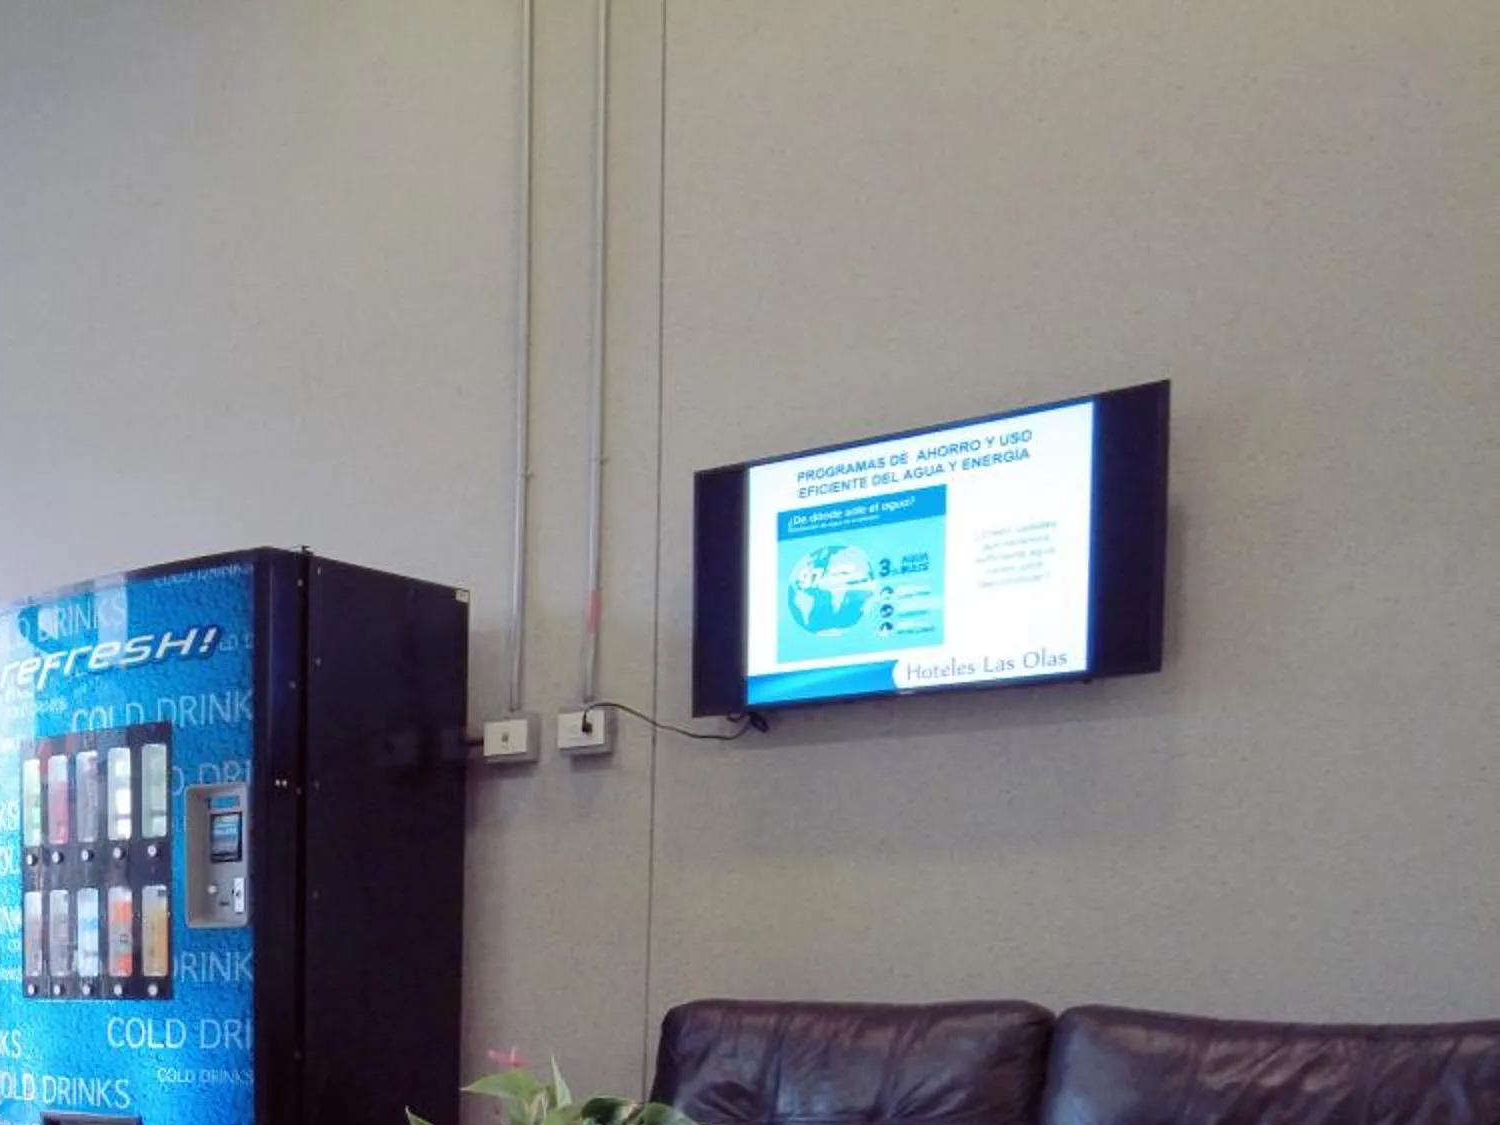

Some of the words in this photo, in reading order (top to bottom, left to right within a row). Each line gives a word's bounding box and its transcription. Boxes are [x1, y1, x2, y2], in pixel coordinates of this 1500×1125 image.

[797, 457, 885, 483] PROGRAMAS
[890, 451, 908, 467] DE
[916, 440, 981, 462] AHORRO
[986, 436, 996, 448] Y
[999, 429, 1033, 446] USO
[798, 476, 868, 498] EFICIENTE
[872, 471, 899, 487] DEL
[903, 463, 945, 481] AGUA
[948, 461, 957, 472] Y
[961, 448, 1031, 470] ENERGÍA
[906, 657, 975, 681] Hoteles
[983, 656, 1015, 673] Las
[1023, 648, 1068, 669] Olas
[72, 702, 145, 732] COLD
[173, 951, 254, 982] RINK
[107, 1017, 187, 1049] COLD
[157, 1066, 195, 1083] COLD
[43, 1075, 131, 1109] DRINKS
